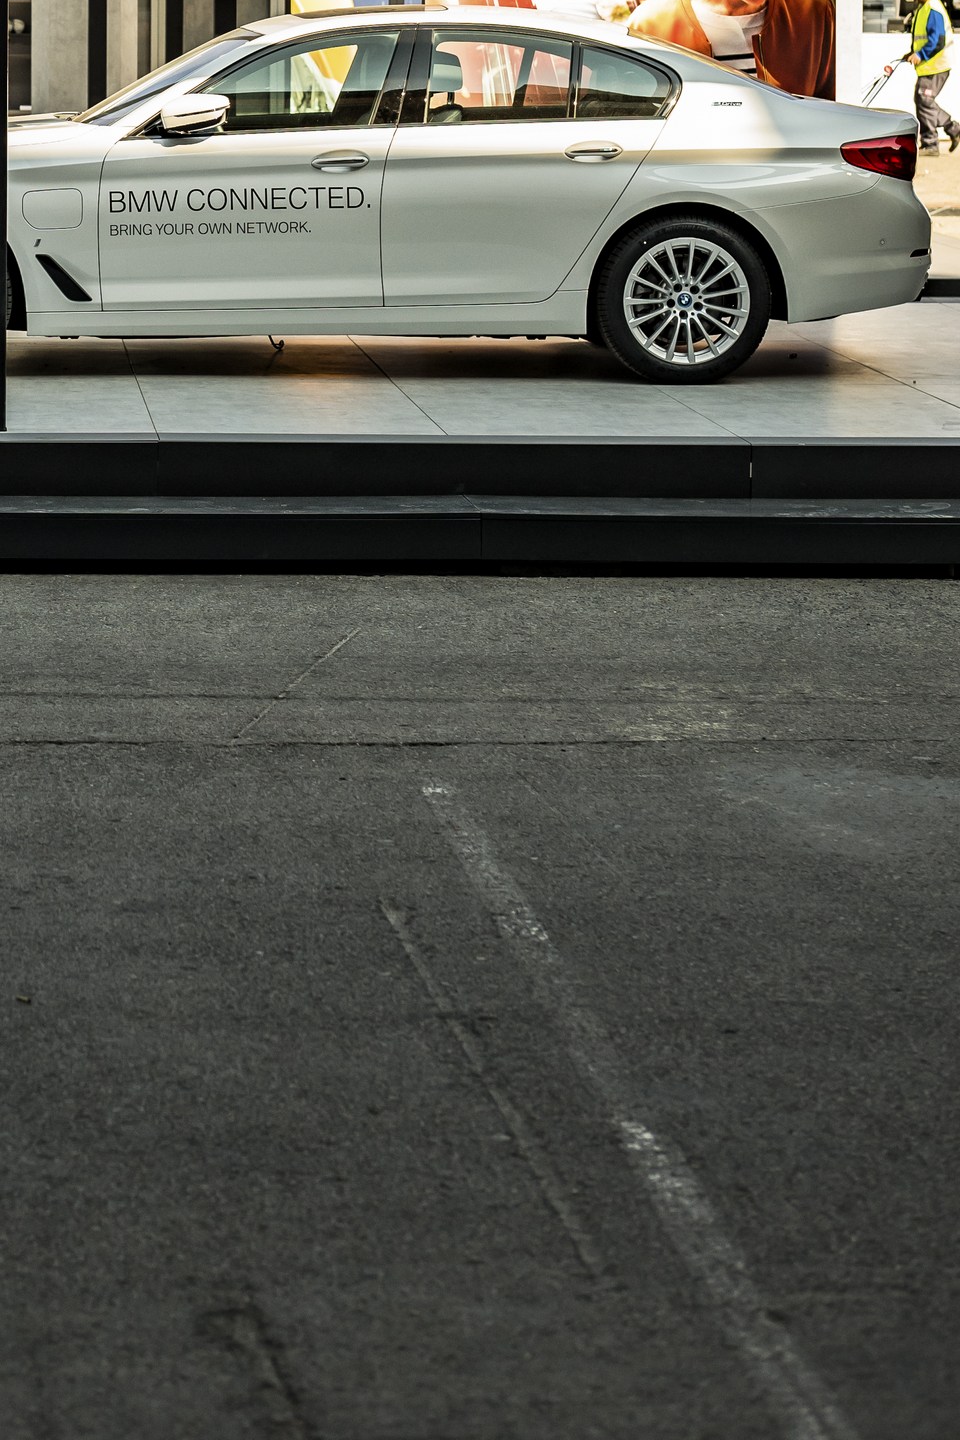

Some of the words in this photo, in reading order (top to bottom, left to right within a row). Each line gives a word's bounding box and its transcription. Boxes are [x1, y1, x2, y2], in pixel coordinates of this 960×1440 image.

[108, 190, 179, 213] BMW
[186, 186, 371, 211] CONNECTED.
[109, 224, 153, 236] BRING
[155, 223, 194, 235] YOUR
[197, 222, 232, 235] OWN
[236, 221, 312, 234] NETWORK.
